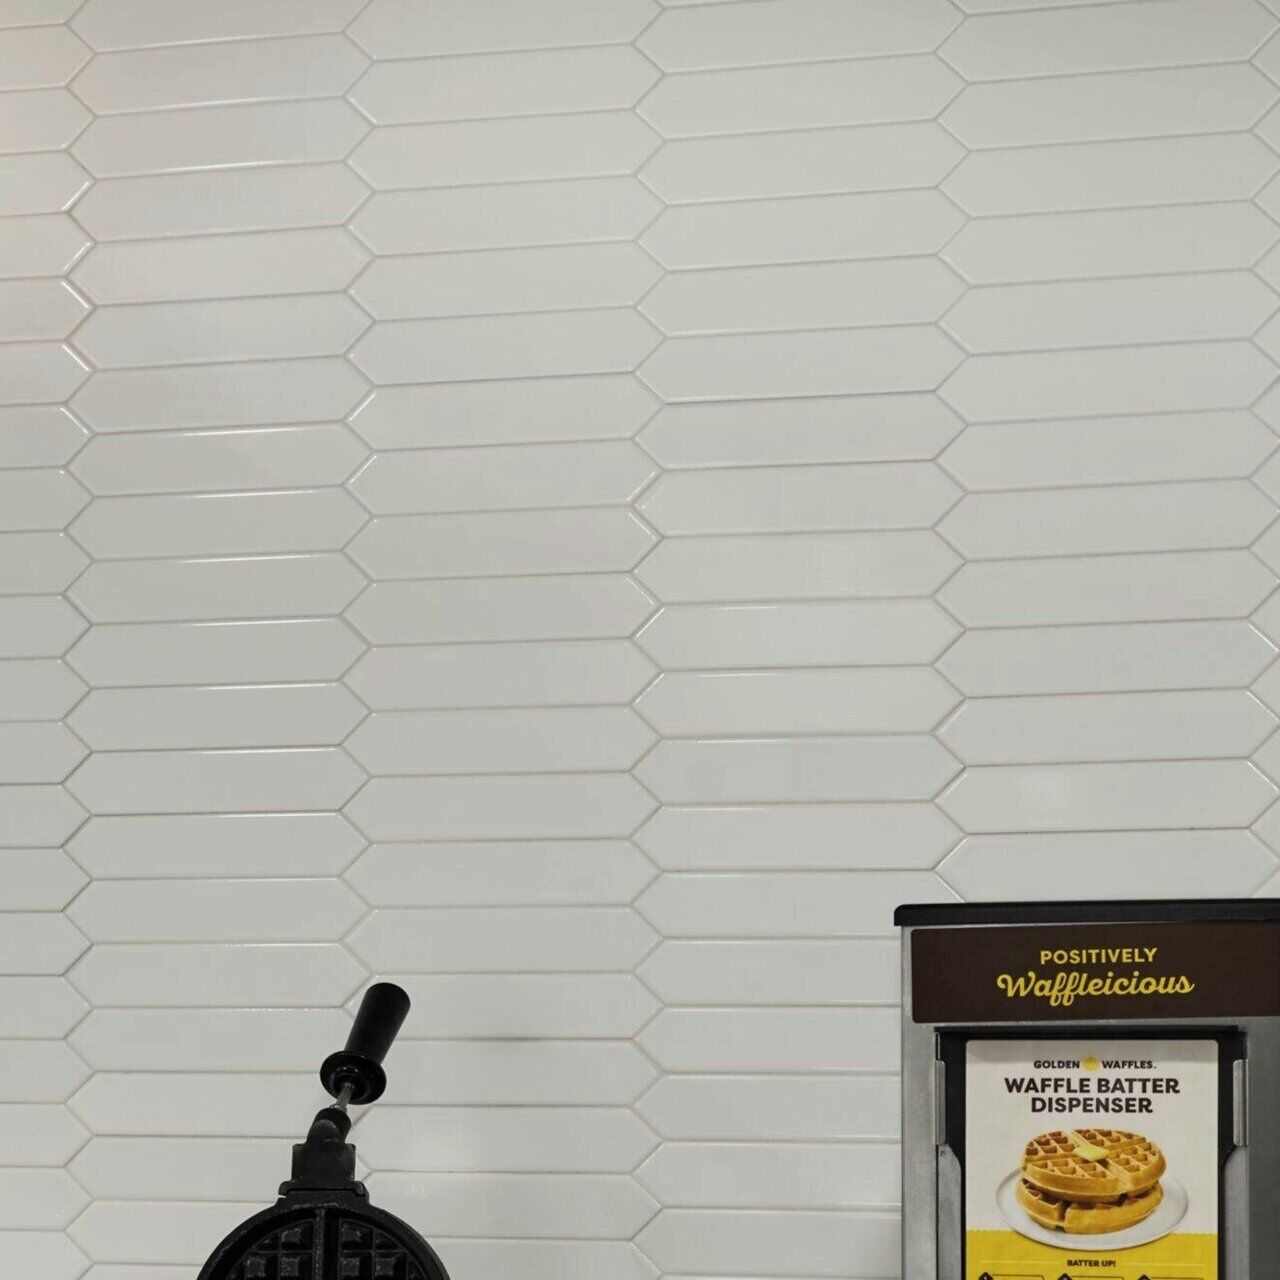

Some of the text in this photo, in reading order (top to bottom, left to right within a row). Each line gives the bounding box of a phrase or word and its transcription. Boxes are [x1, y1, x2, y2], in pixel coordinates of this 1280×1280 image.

[1040, 948, 1158, 965] POSITIVELY
[996, 970, 1195, 1007] Waffleicious
[1033, 1060, 1080, 1069] GOLDEN
[1004, 1078, 1180, 1094] WAFFLE BATTER
[1031, 1097, 1153, 1113] DISPENSER
[1101, 1260, 1116, 1268] UP!
